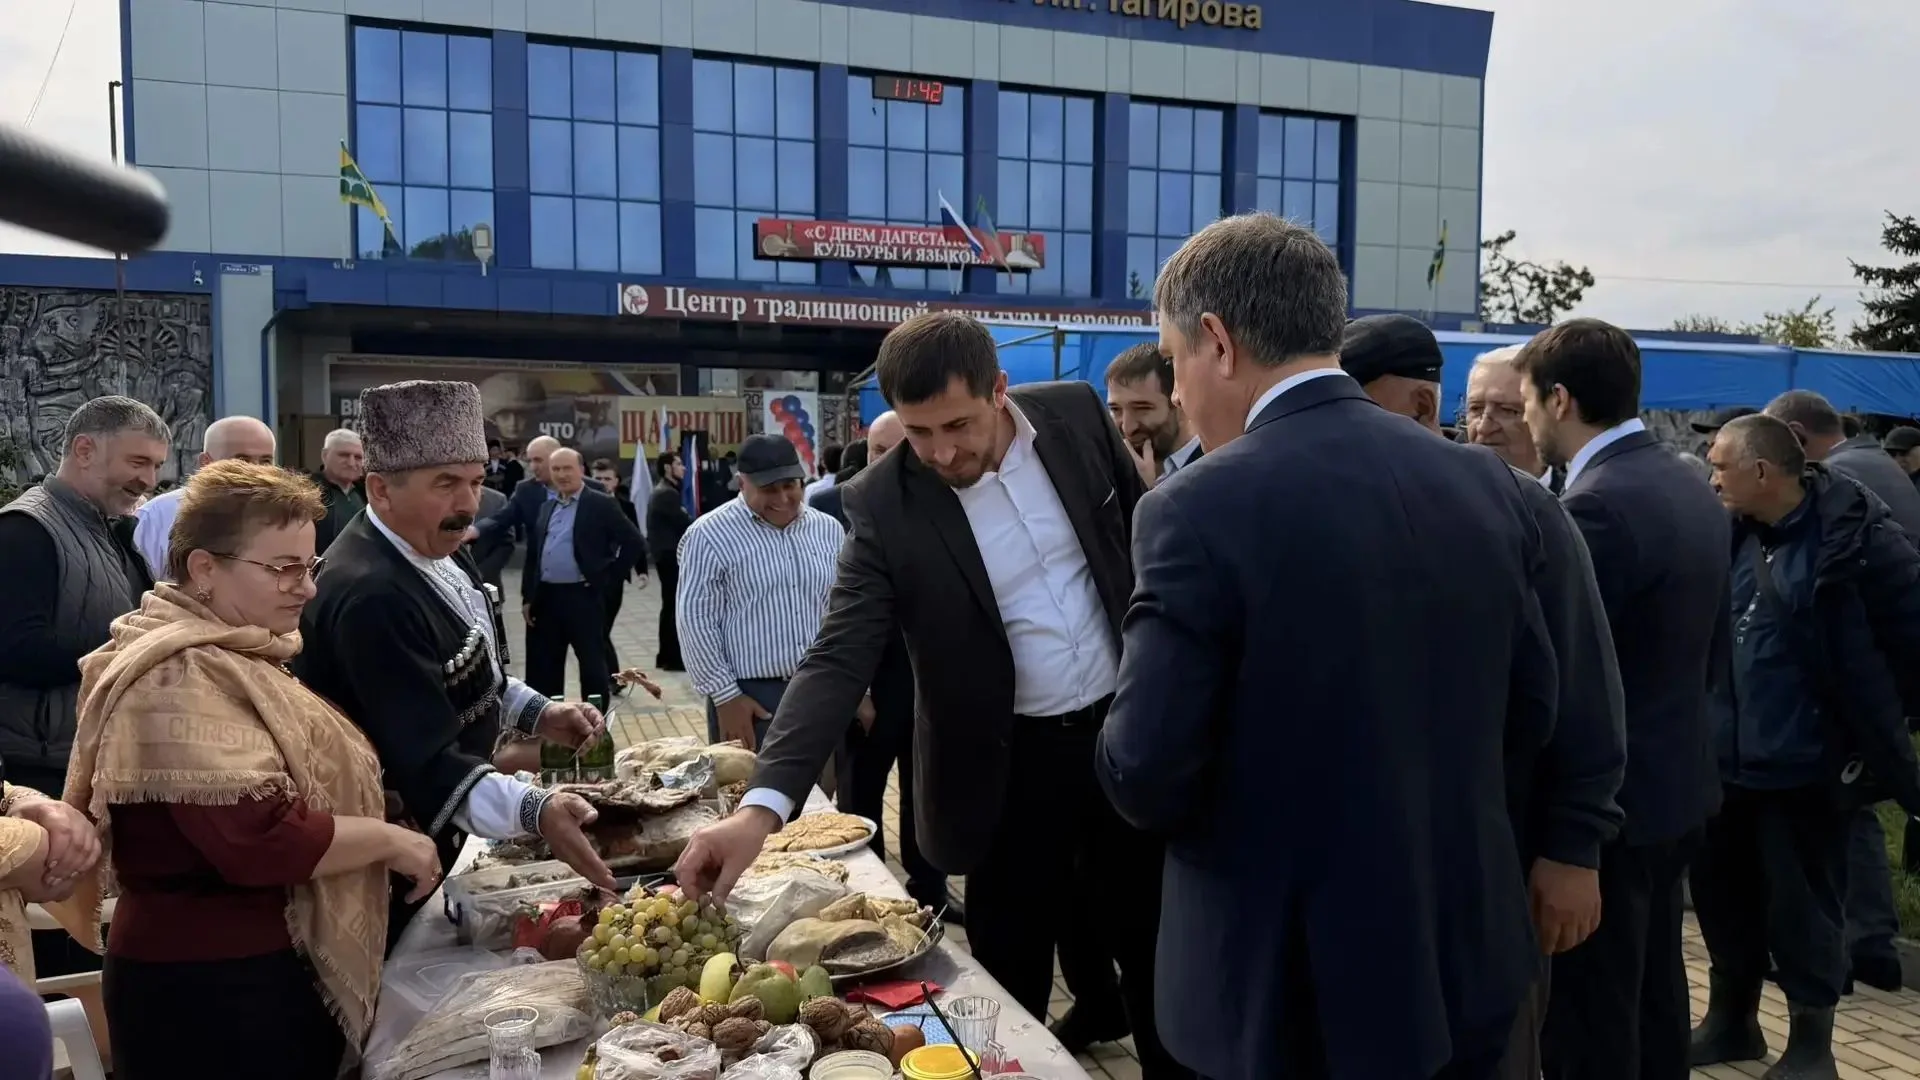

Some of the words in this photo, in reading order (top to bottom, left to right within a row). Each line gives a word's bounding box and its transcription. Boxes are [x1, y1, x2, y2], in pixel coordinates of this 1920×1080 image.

[894, 80, 943, 102] 11:42
[829, 226, 876, 243] ДНЕМ
[813, 242, 898, 261] КУЛЬТУРЫ
[902, 247, 912, 262] И
[664, 286, 747, 321] Центр
[753, 298, 928, 323] традиционной
[539, 422, 574, 439] ЧТО
